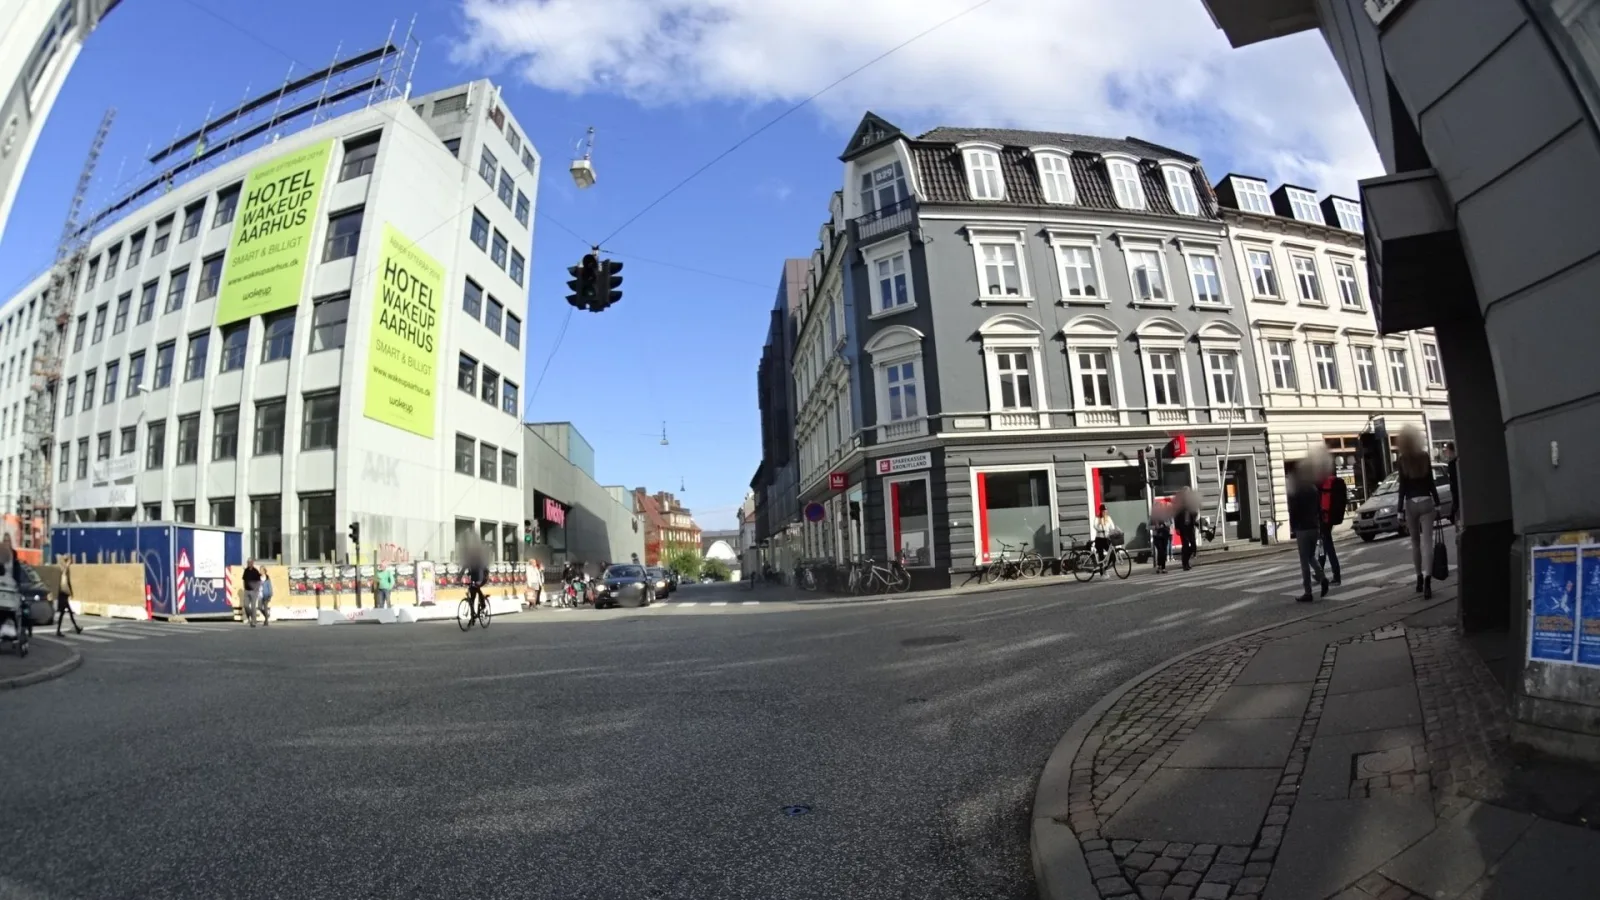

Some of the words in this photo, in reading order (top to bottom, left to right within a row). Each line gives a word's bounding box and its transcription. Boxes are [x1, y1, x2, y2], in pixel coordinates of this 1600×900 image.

[245, 169, 315, 210] HOTEL
[876, 168, 893, 181] B29
[243, 190, 313, 227] WAKEUP
[237, 209, 307, 247] AARHUS
[231, 249, 260, 268] SMART
[260, 248, 267, 258] &
[268, 236, 304, 255] BILLIGT
[228, 258, 299, 286] www.wakeupaarhus.dk
[384, 257, 436, 314] HOTEL
[383, 284, 435, 331] WAKEUP
[379, 308, 434, 353] AARHUS
[375, 338, 401, 361] SMART
[401, 353, 407, 365] &
[407, 355, 432, 376] BILLIGT
[373, 365, 431, 397] www.wakeupaarhus.dk
[892, 455, 927, 464] SPAREKASSEN
